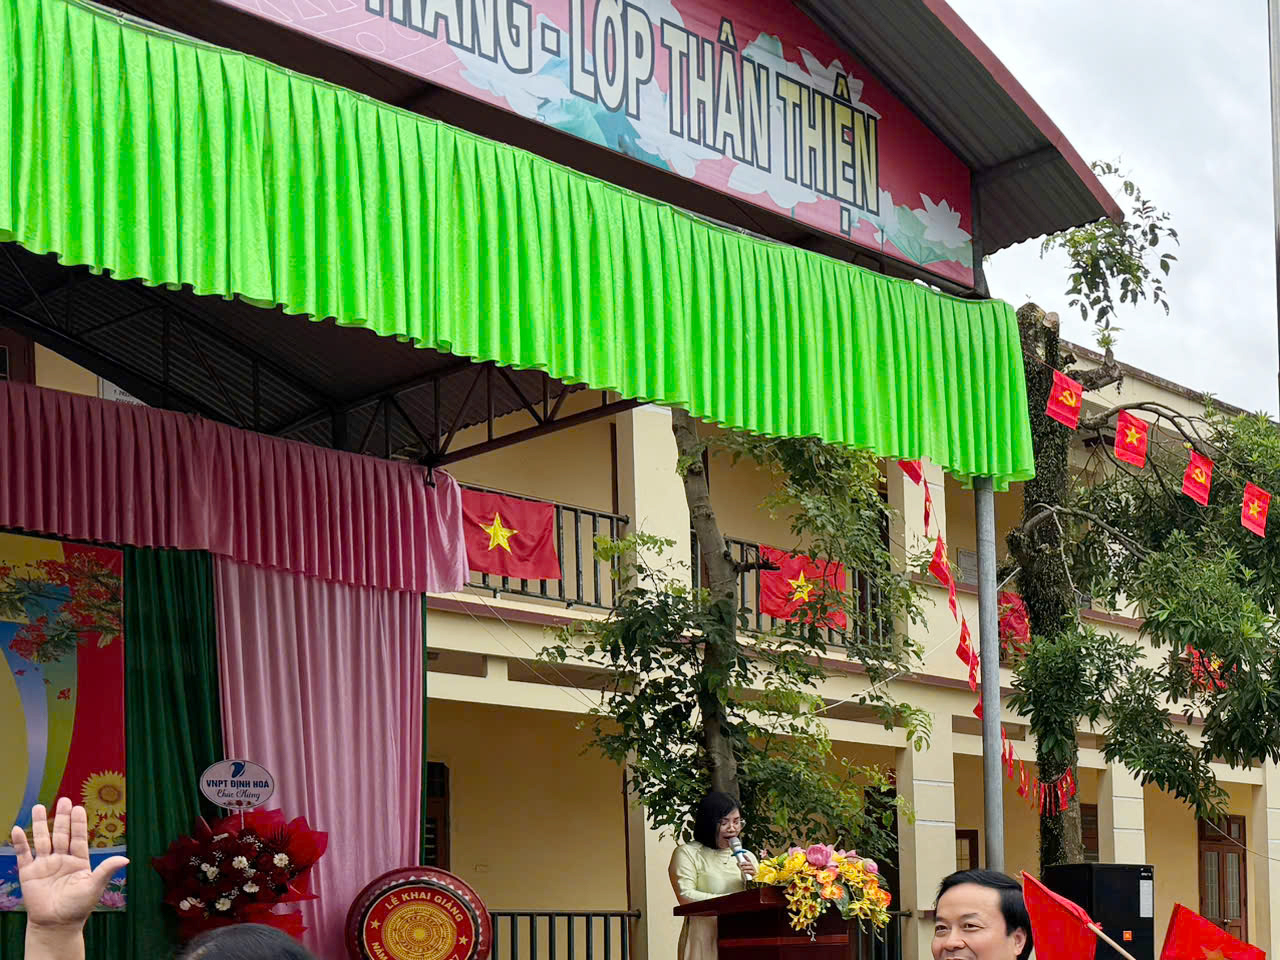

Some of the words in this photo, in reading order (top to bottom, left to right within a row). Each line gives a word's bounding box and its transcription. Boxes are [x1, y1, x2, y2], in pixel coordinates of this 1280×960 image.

[660, 16, 772, 174] THÂN
[776, 72, 880, 237] THIỆN
[206, 780, 227, 788] VNPT
[230, 780, 251, 789] ĐỊNH
[217, 789, 234, 798] Chúc
[385, 895, 400, 910] LỄ
[401, 891, 431, 901] KHAI
[434, 895, 464, 922] GIẢNG
